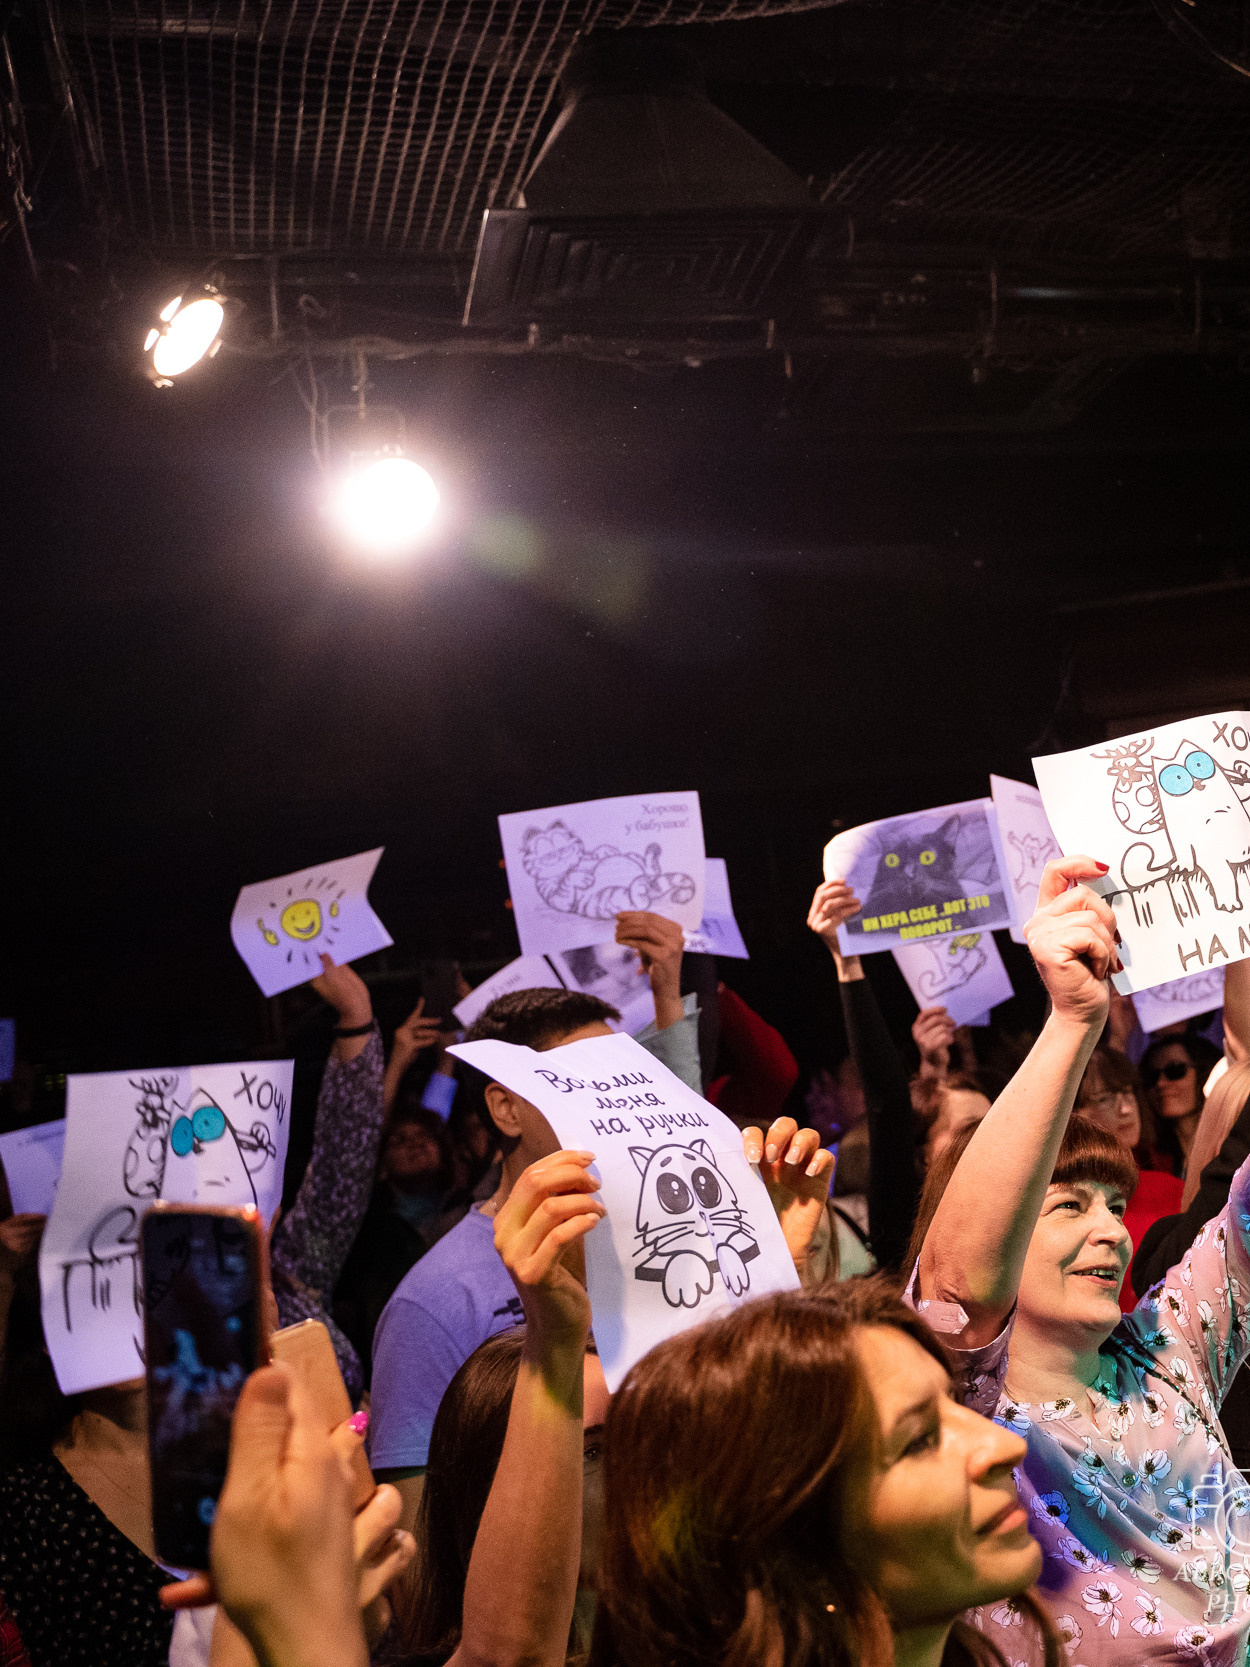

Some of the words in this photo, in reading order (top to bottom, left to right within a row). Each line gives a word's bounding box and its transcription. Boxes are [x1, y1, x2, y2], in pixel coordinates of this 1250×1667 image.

[862, 917, 880, 932] НИ
[880, 911, 909, 929] ХЕРА
[966, 894, 990, 911] ЭТО
[1177, 933, 1229, 972] НА
[534, 1069, 653, 1093] Воьми
[233, 1071, 287, 1124] ХОЧУ
[596, 1092, 666, 1110] меня
[590, 1116, 631, 1136] на
[635, 1112, 709, 1137] ручки
